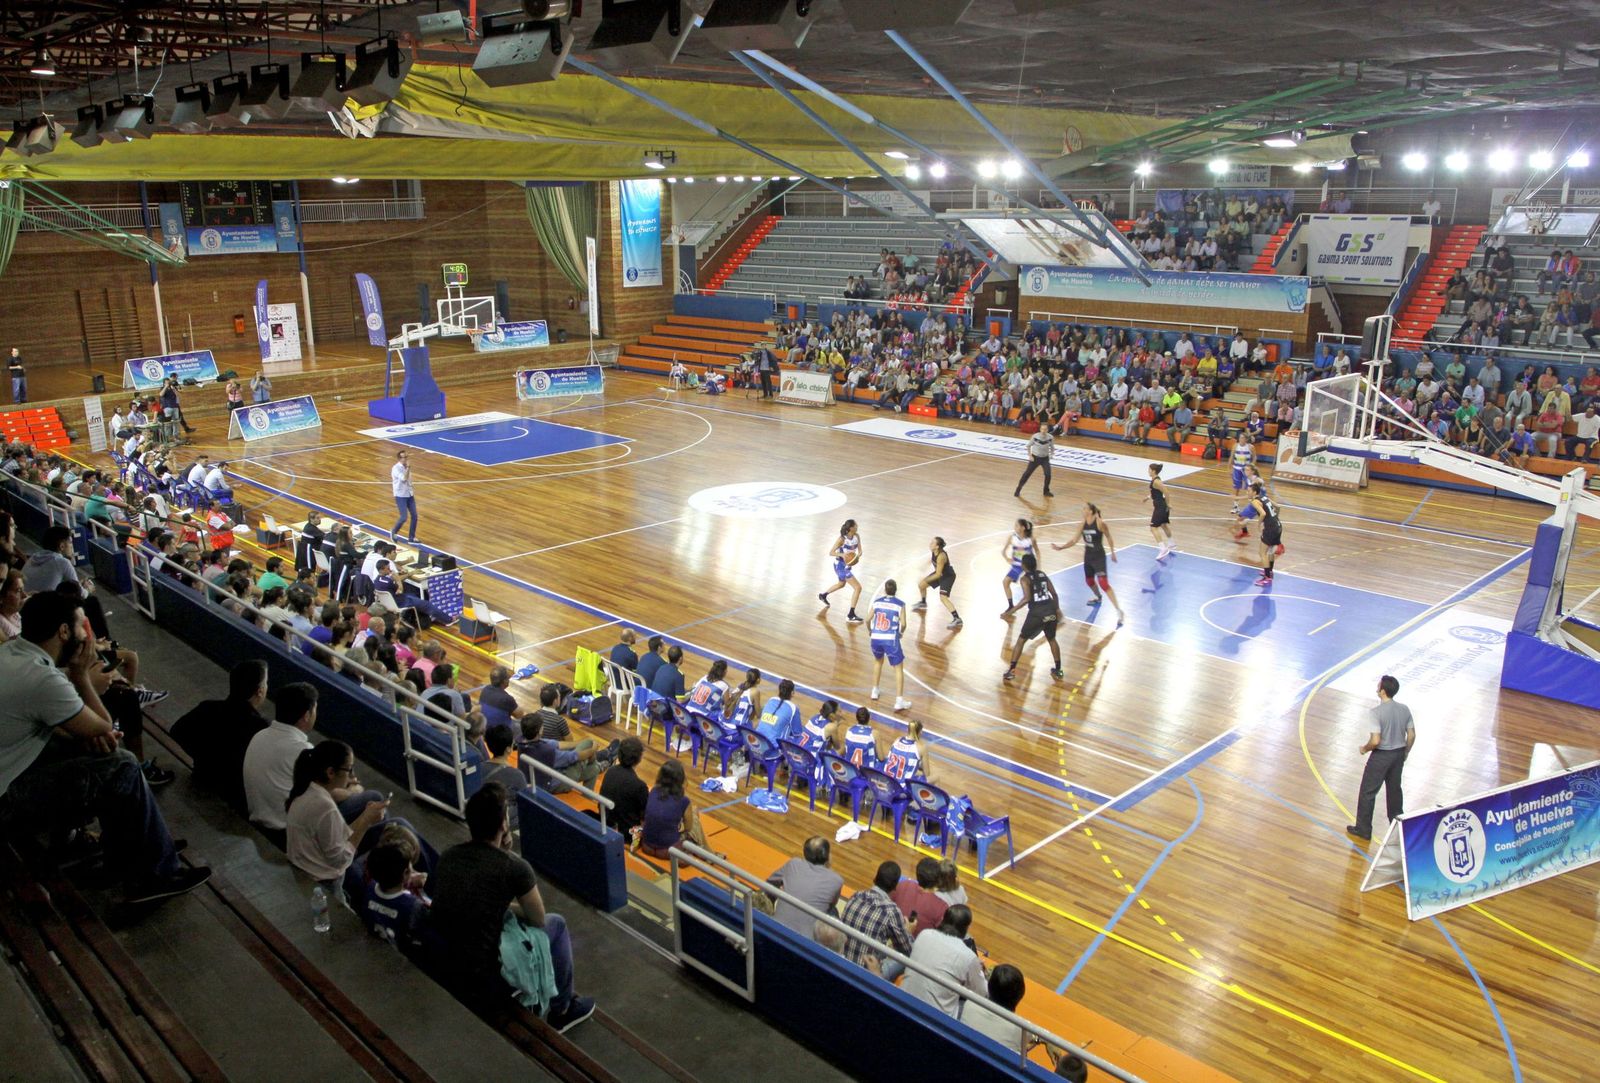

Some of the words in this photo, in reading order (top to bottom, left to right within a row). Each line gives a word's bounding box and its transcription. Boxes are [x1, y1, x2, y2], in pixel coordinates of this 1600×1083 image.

[219, 181, 239, 189] 4:05
[222, 230, 260, 238] Ayuntamiento
[1335, 233, 1376, 253] GSS
[1340, 256, 1360, 265] SPORT
[1050, 270, 1094, 279] Ayuntamiento
[162, 357, 198, 366] Ayuntamiento
[1329, 457, 1360, 469] chica
[850, 748, 863, 768] 4
[884, 754, 906, 779] 21
[1485, 790, 1574, 826] Ayuntamiento
[1515, 819, 1528, 833] de
[1530, 805, 1574, 828] Huelva
[1532, 830, 1542, 838] de
[1542, 820, 1575, 836] Deportes
